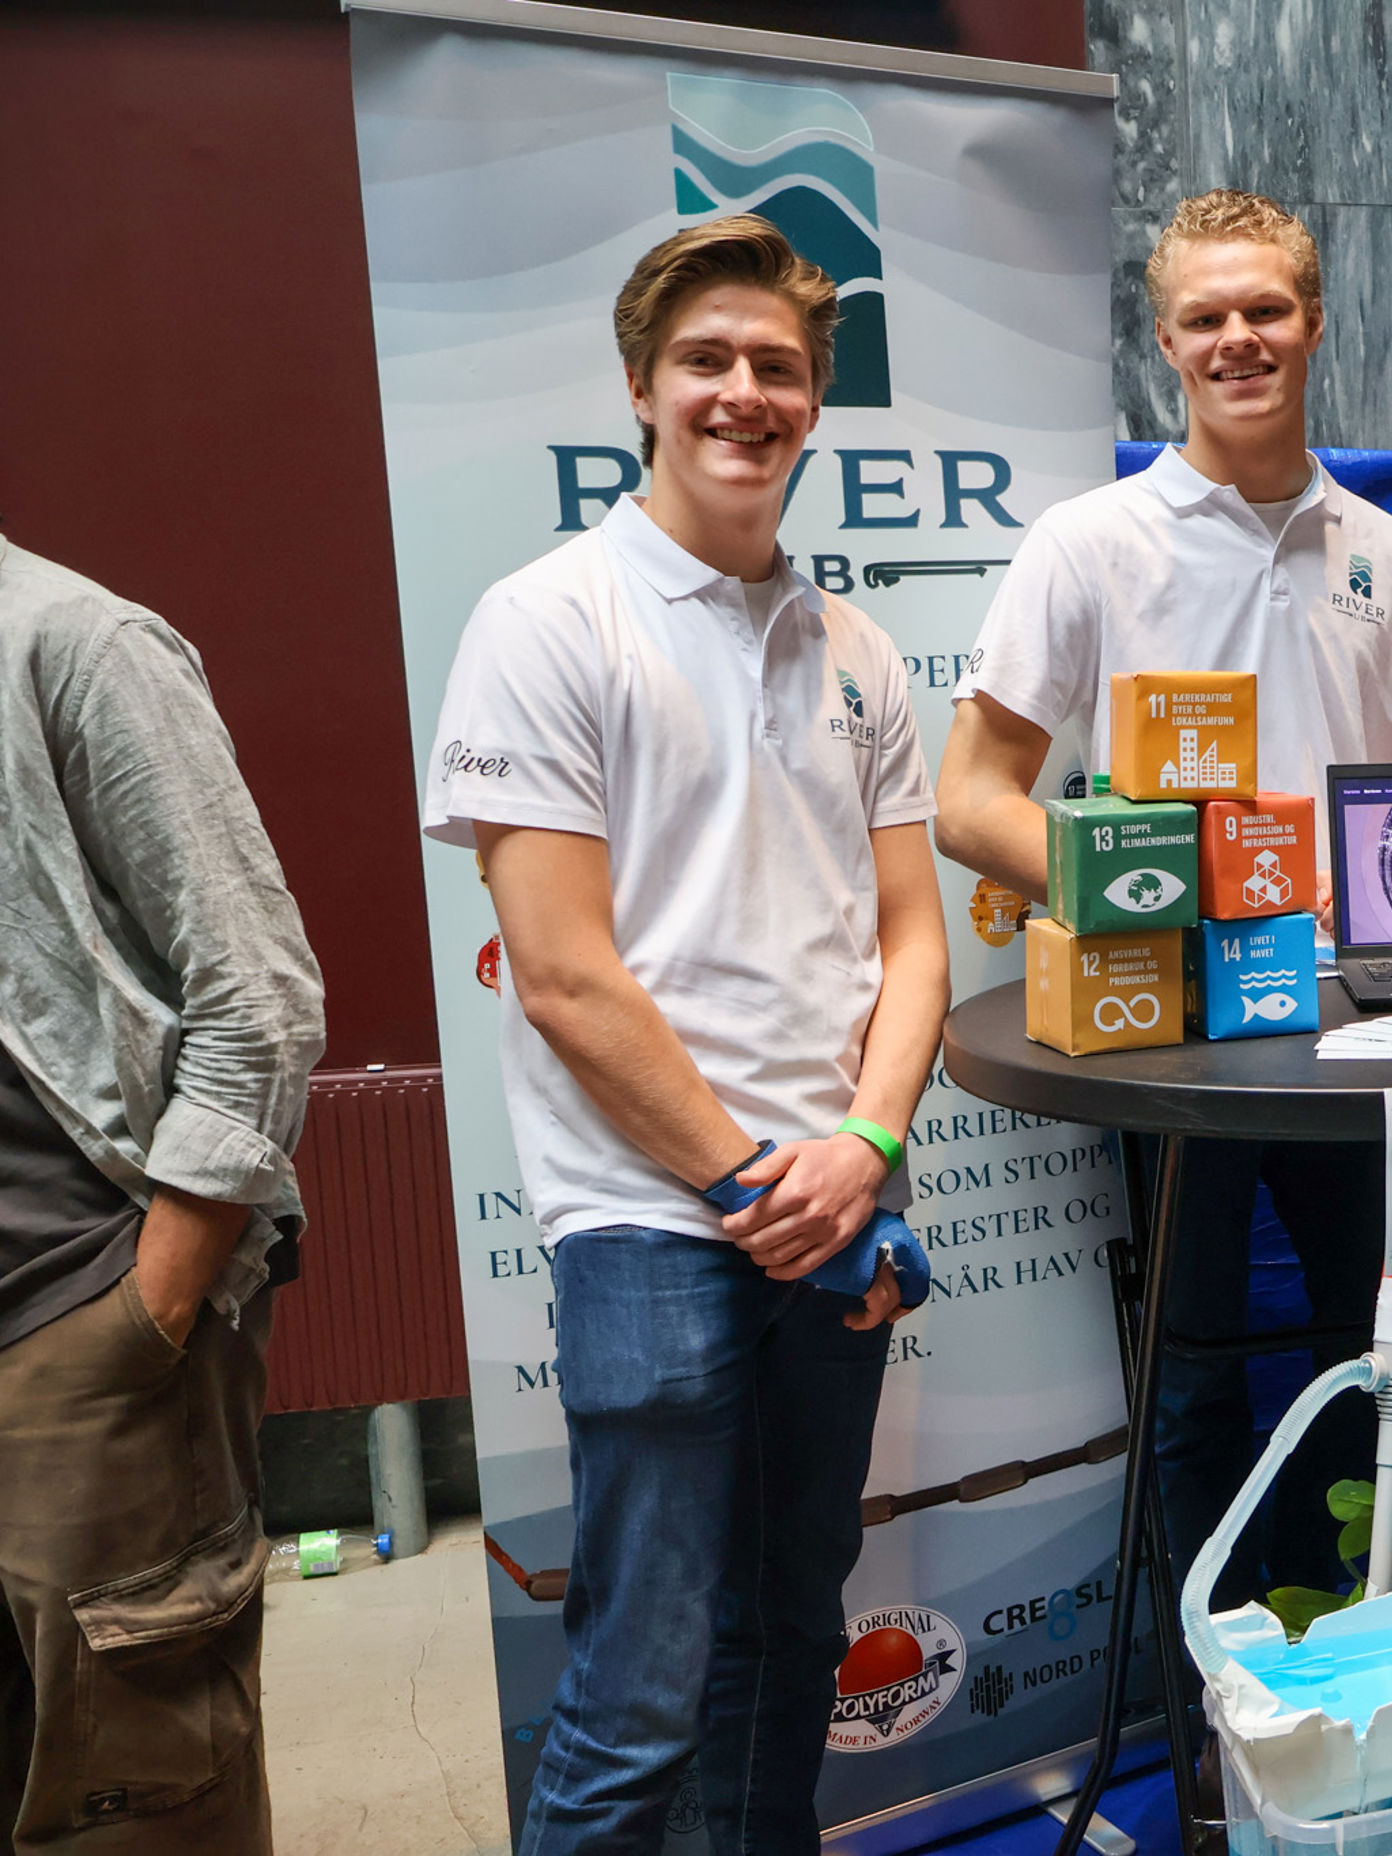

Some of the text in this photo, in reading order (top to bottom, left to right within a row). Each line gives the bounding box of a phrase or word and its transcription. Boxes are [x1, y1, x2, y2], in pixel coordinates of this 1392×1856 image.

[1332, 593, 1385, 621] RIVER
[1149, 694, 1166, 718] 11
[1172, 693, 1233, 702] BÆREKRAFTIGE
[1172, 705, 1207, 714] BYER OG
[829, 718, 876, 742] RVER
[1171, 716, 1235, 726] LOKALSAMFUNN
[442, 740, 512, 782] River
[1092, 826, 1114, 852] 13
[1121, 824, 1152, 835] STOPPE
[1225, 816, 1237, 840] 9
[1242, 824, 1295, 837] INNOVASJON OG
[1121, 834, 1196, 849] KLIMAENDRINGENE
[1242, 836, 1298, 848] INFRASTRUKTUR
[1221, 938, 1242, 962] 14
[1250, 935, 1271, 946] LIVET
[1081, 952, 1101, 977] 12
[1109, 947, 1151, 960] ANSVARLIG
[1250, 948, 1274, 959] HAVET
[1108, 960, 1159, 973] FORBRUK OG
[1109, 974, 1159, 987] PRODUKSJON
[918, 1162, 993, 1199] SOM
[475, 1189, 533, 1221] IN
[1064, 1193, 1111, 1225] OG
[930, 1263, 1004, 1303] NÅR
[1015, 1249, 1083, 1285] HAV
[857, 1610, 937, 1636] ORIGINAL
[1023, 1654, 1084, 1690] NORD
[831, 1671, 937, 1721] POLYFORM
[895, 1696, 942, 1736] NORWAY
[827, 1730, 878, 1747] MADE IN
